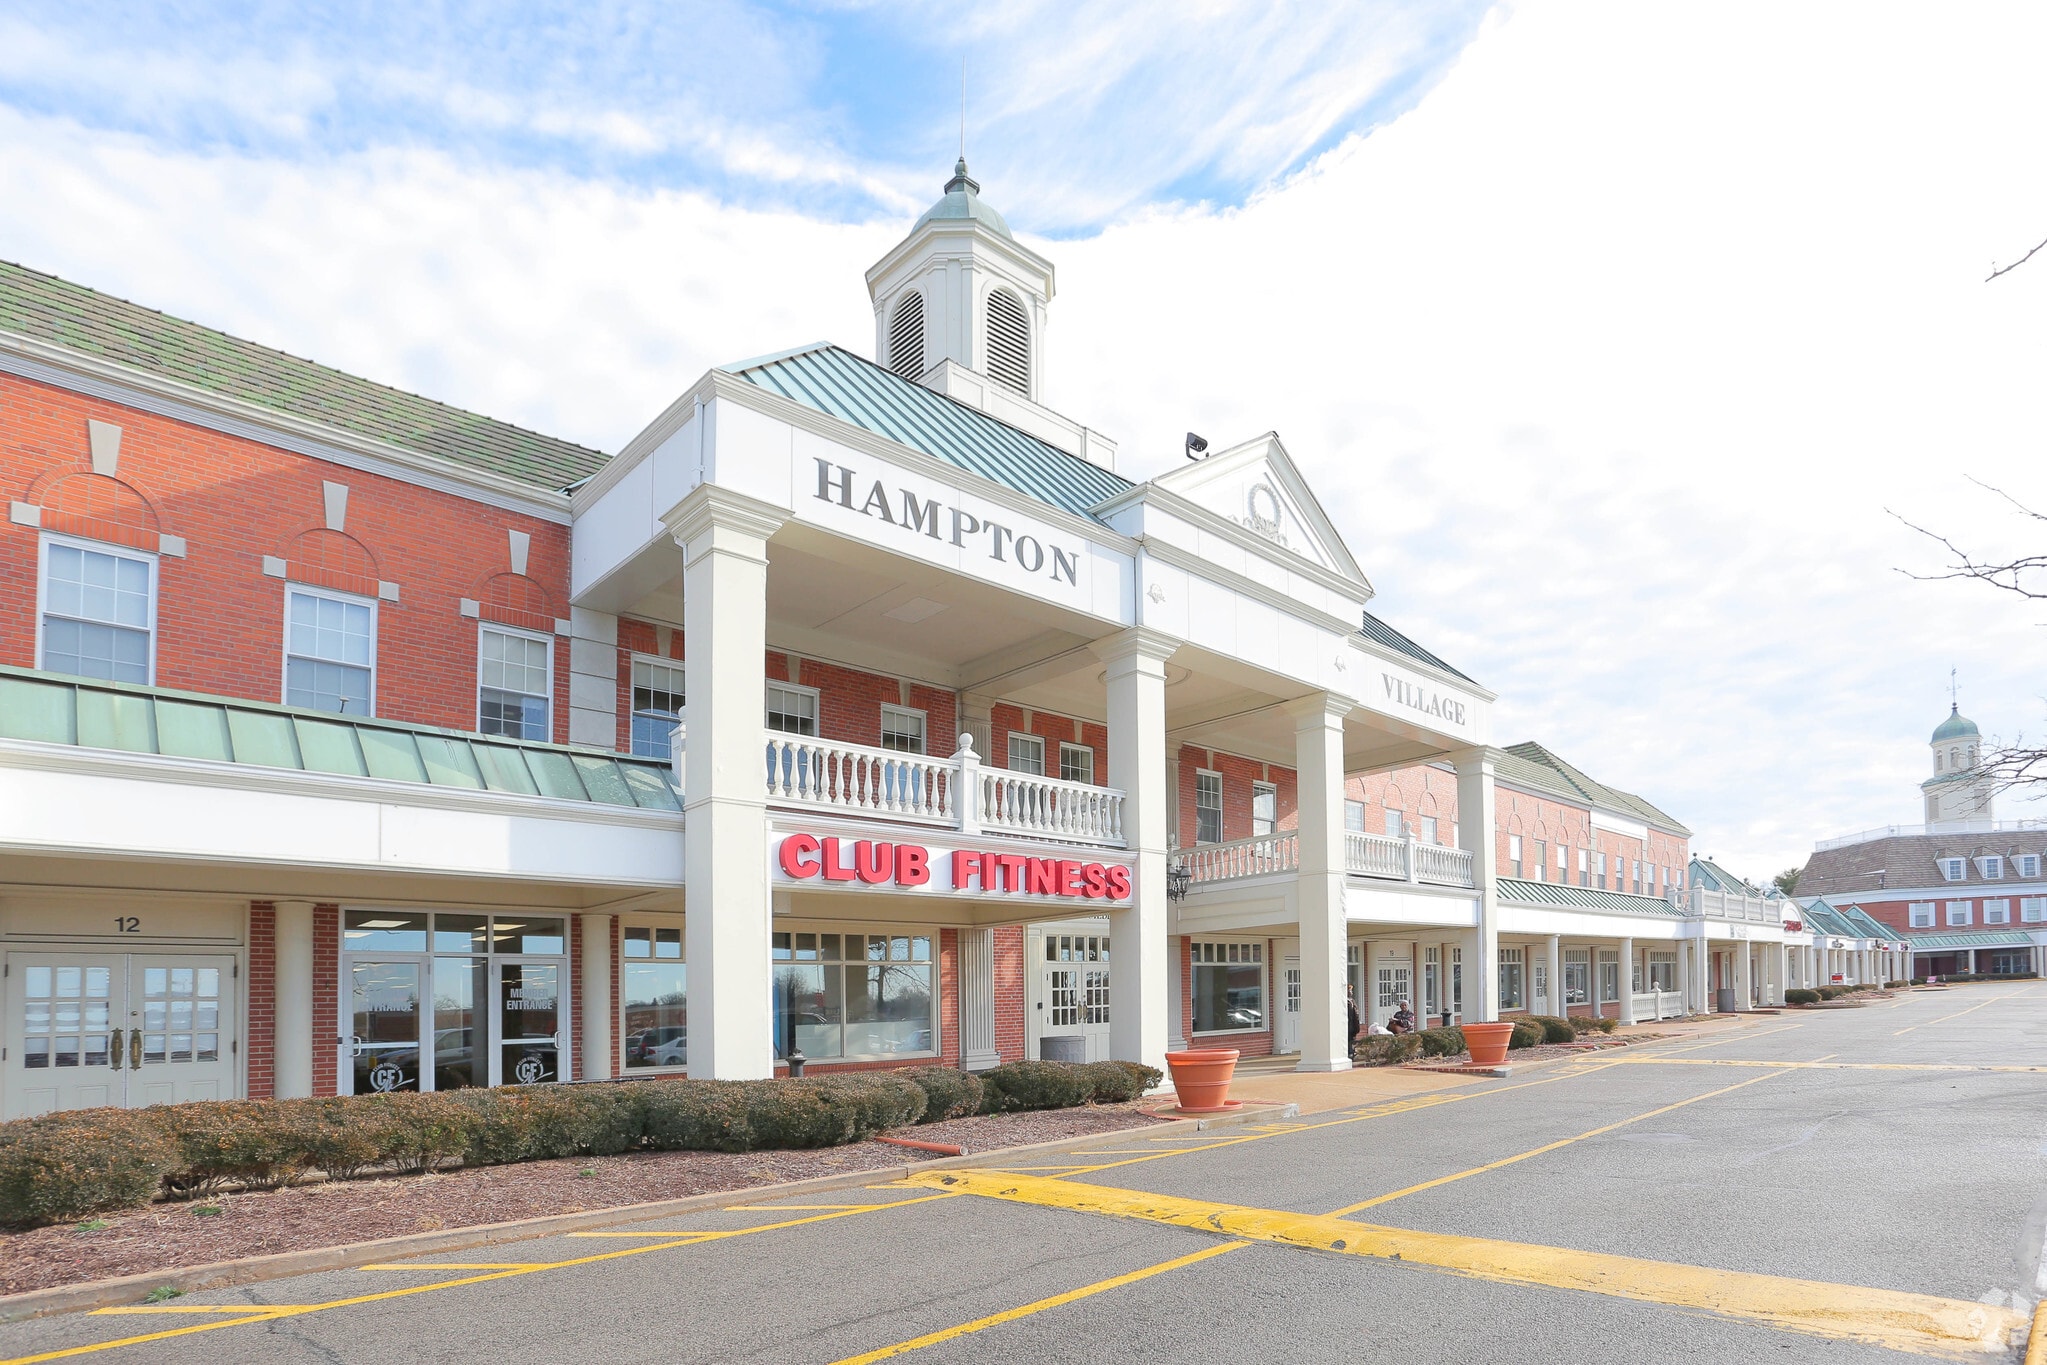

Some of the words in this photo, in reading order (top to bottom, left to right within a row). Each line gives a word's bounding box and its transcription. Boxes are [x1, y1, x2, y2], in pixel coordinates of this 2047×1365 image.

[812, 456, 1080, 587] HAMPTON
[1381, 672, 1466, 726] VILLAGE
[779, 833, 930, 886] CLUB
[952, 849, 1131, 900] FITNESS
[114, 916, 140, 932] 12
[507, 1000, 553, 1010] ENTRANCE
